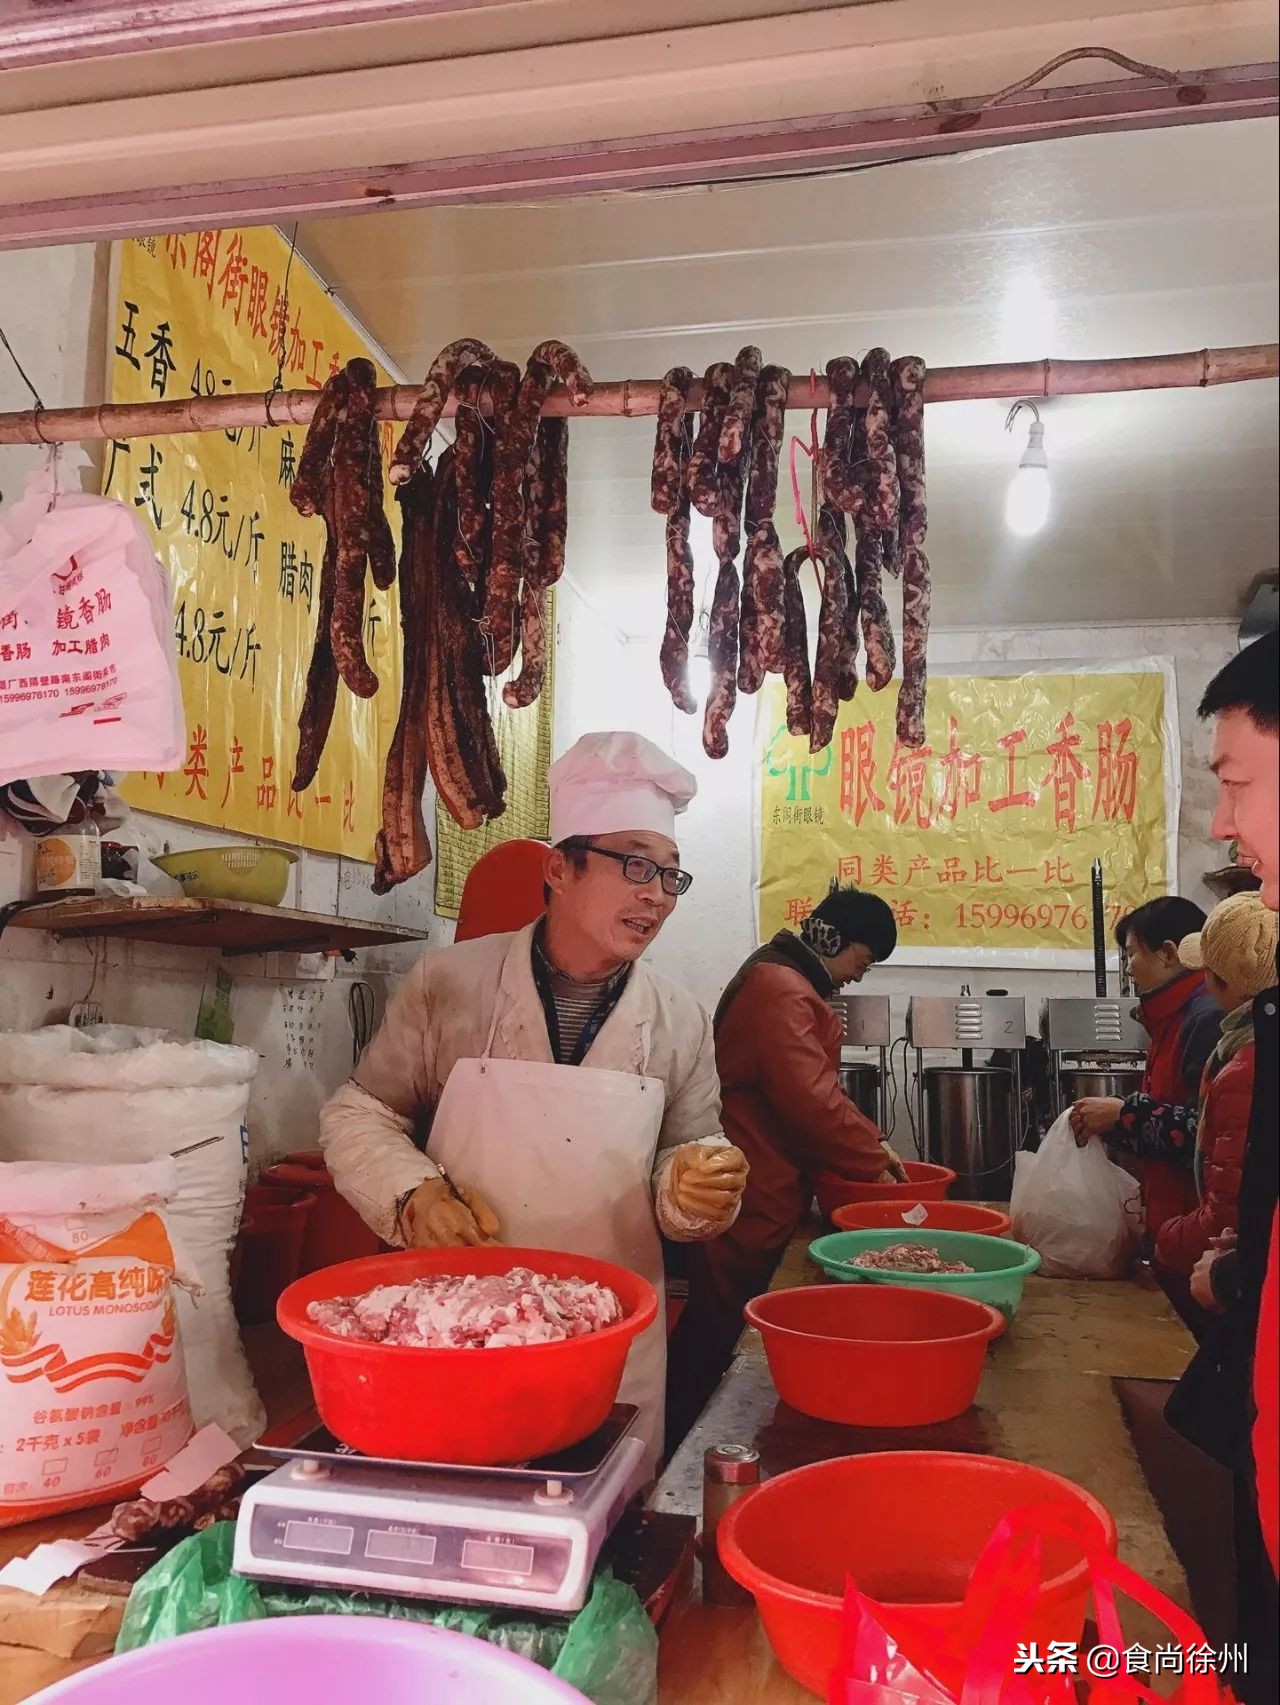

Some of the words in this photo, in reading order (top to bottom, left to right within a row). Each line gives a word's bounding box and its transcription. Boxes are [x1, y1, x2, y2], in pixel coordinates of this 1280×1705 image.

[114, 300, 176, 398] 五香
[104, 437, 162, 531] 广式
[180, 479, 266, 583] 4.8元/斤
[278, 540, 314, 615] 腊肉
[52, 632, 110, 656] 加工腊肉
[174, 599, 262, 695] 4.8元/斤
[143, 723, 355, 833] 类产品比一比
[838, 710, 1140, 835] 眼镜加工香肠
[837, 854, 1076, 886] 同类产品比一比
[49, 1305, 90, 1317] LOTUS
[42, 1476, 61, 1488] 40
[94, 1466, 112, 1479] 60
